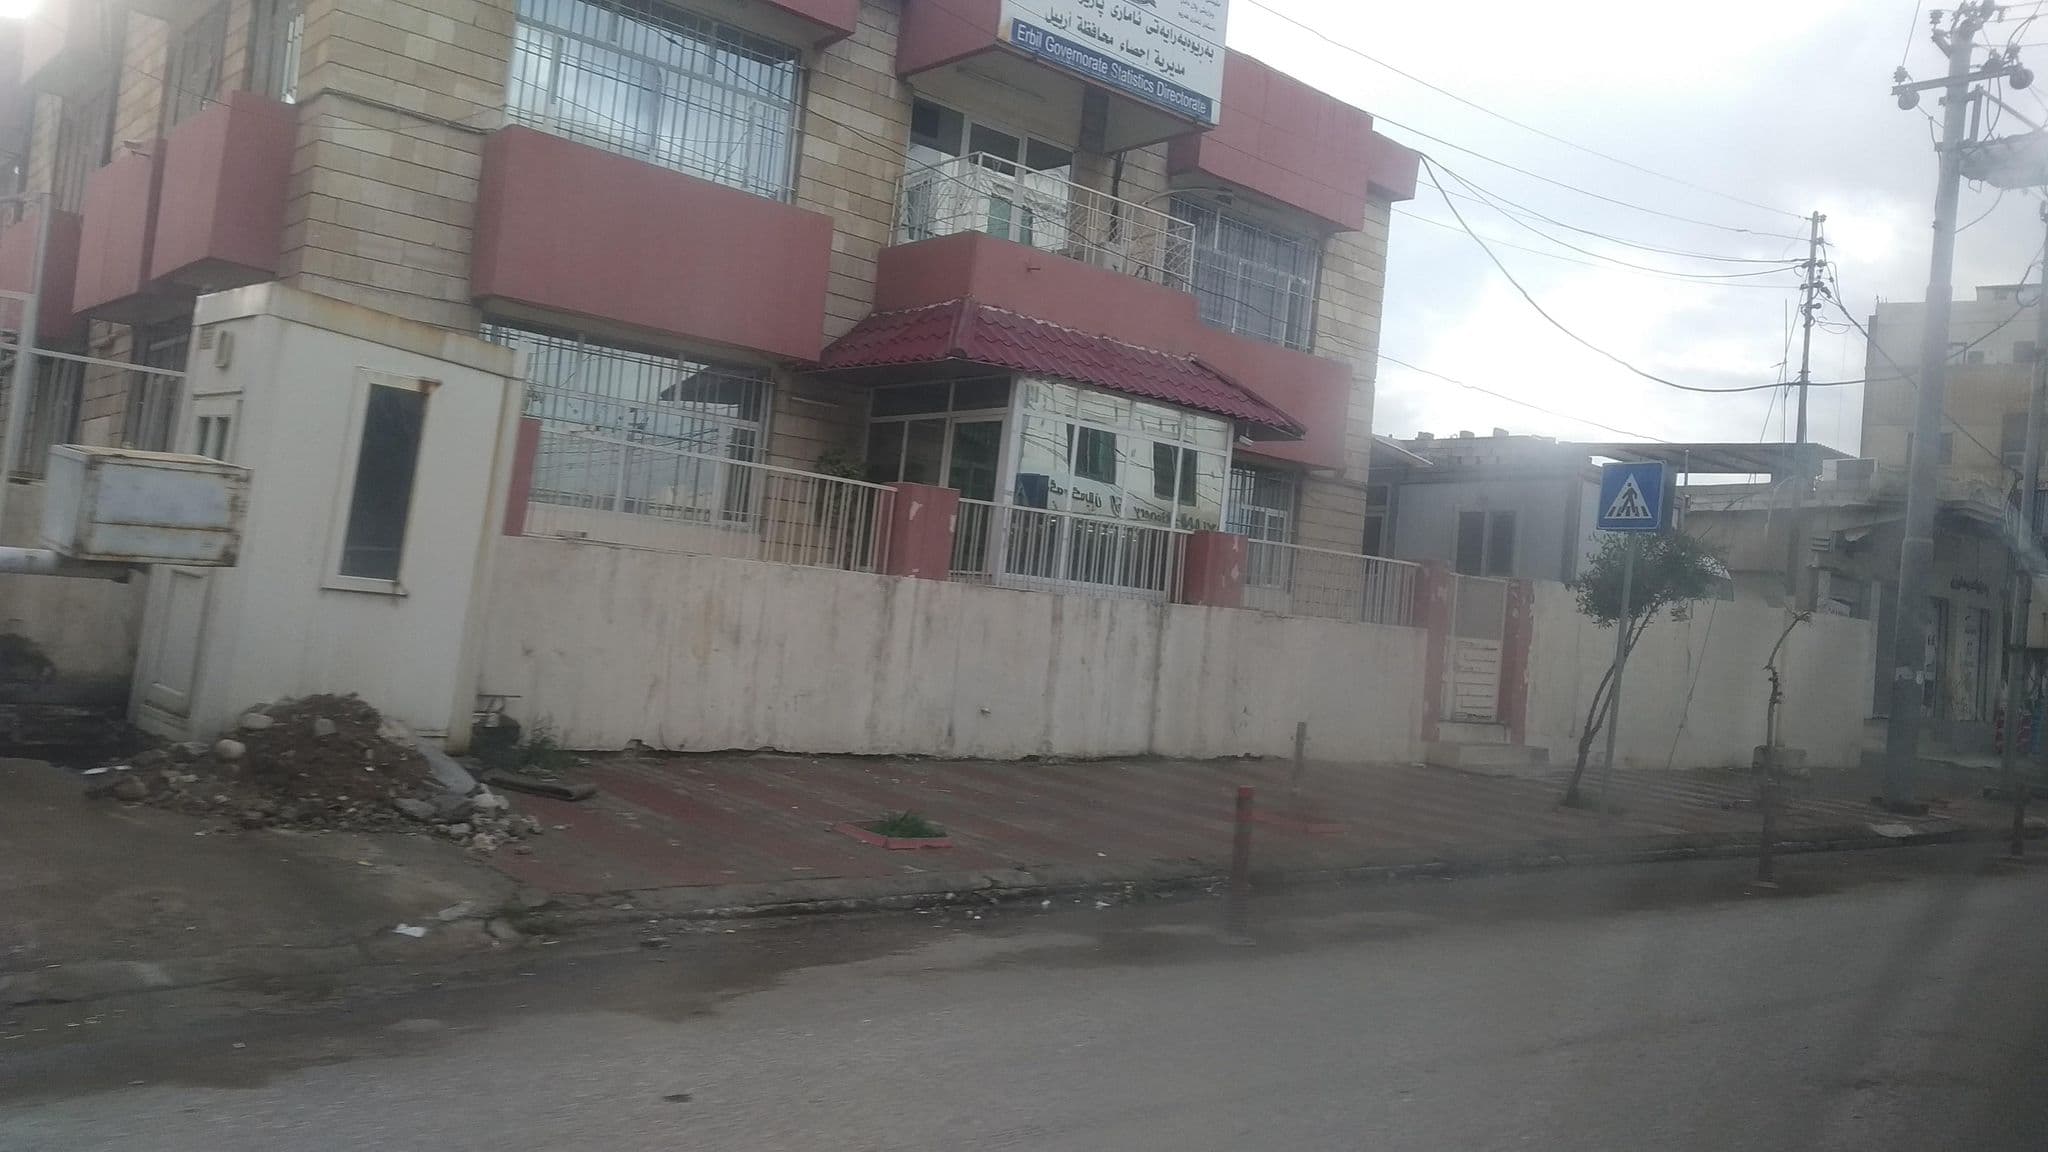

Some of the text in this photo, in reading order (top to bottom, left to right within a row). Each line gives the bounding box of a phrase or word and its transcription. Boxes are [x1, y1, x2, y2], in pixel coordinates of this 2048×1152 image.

[1017, 23, 1206, 114] Erbil Governorate Statistics Directorate
